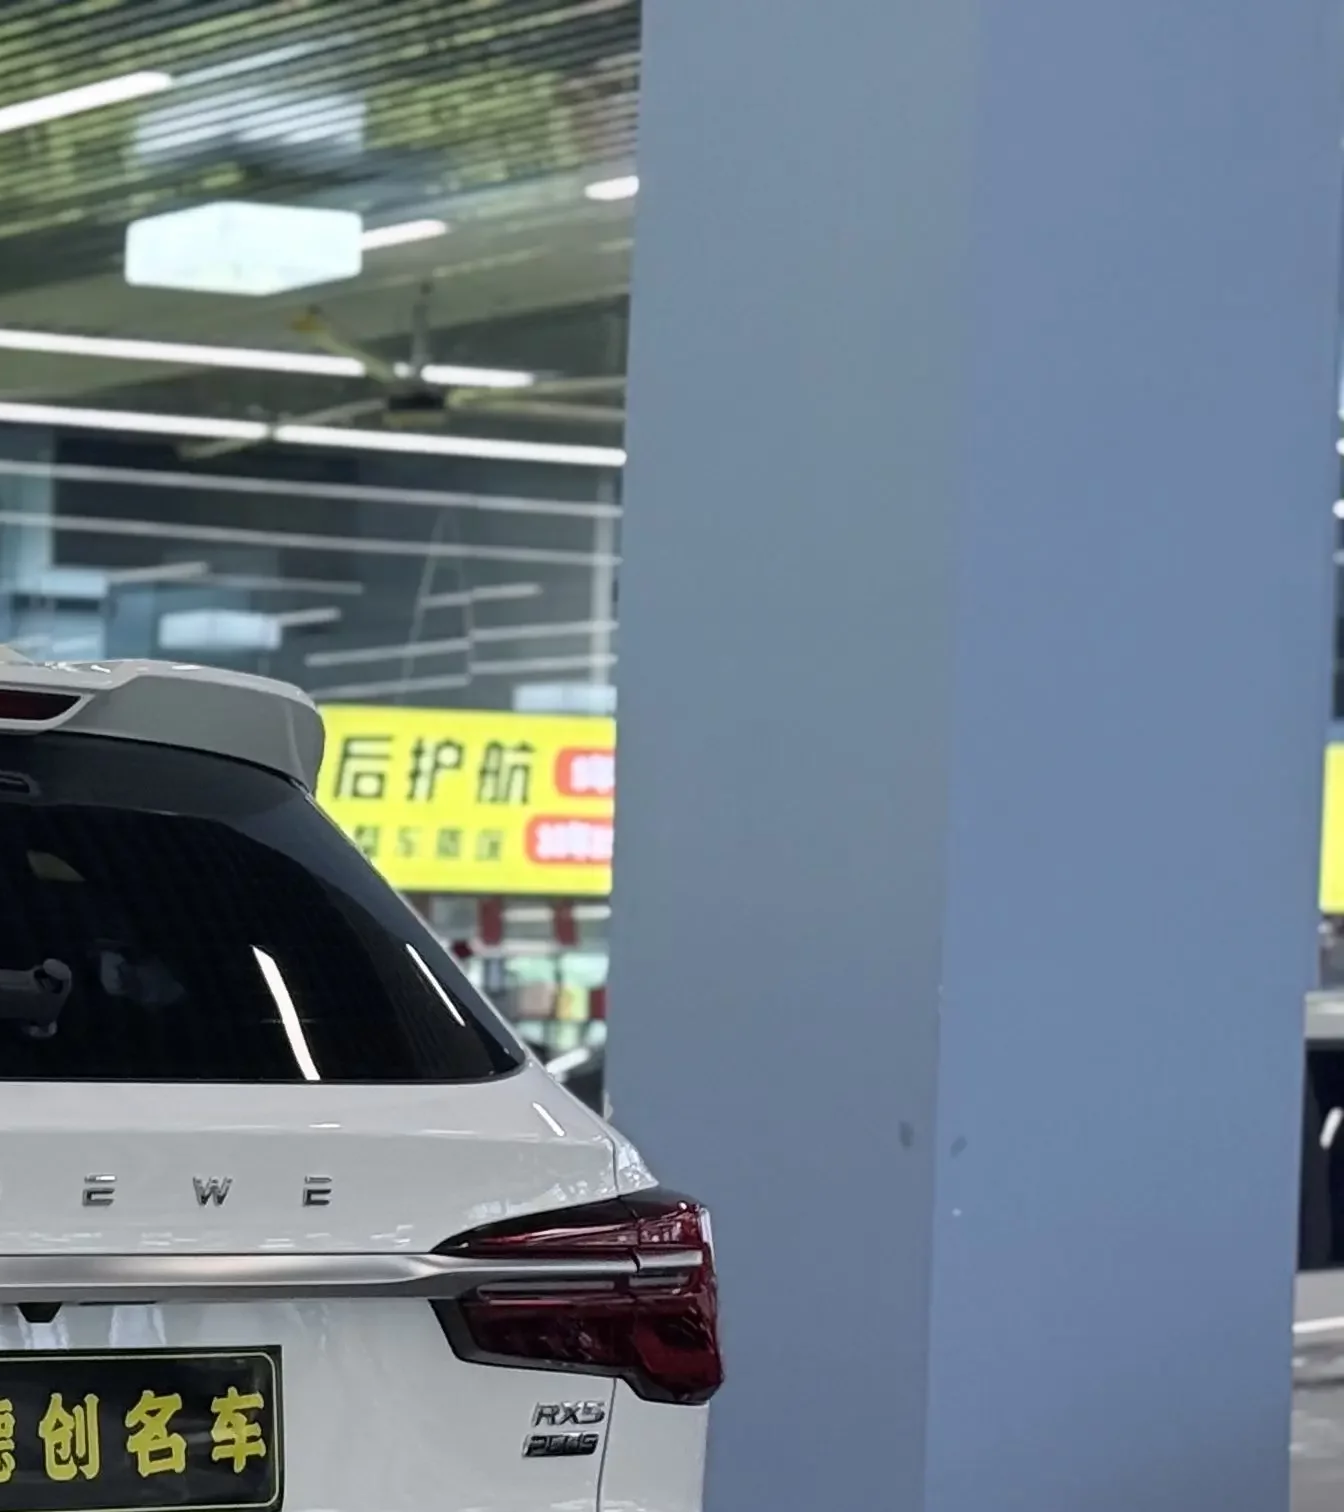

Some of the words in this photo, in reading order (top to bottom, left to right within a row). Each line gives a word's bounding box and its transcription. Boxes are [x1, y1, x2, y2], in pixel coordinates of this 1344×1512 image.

[333, 735, 534, 805] 后护航
[531, 1400, 605, 1427] RX5
